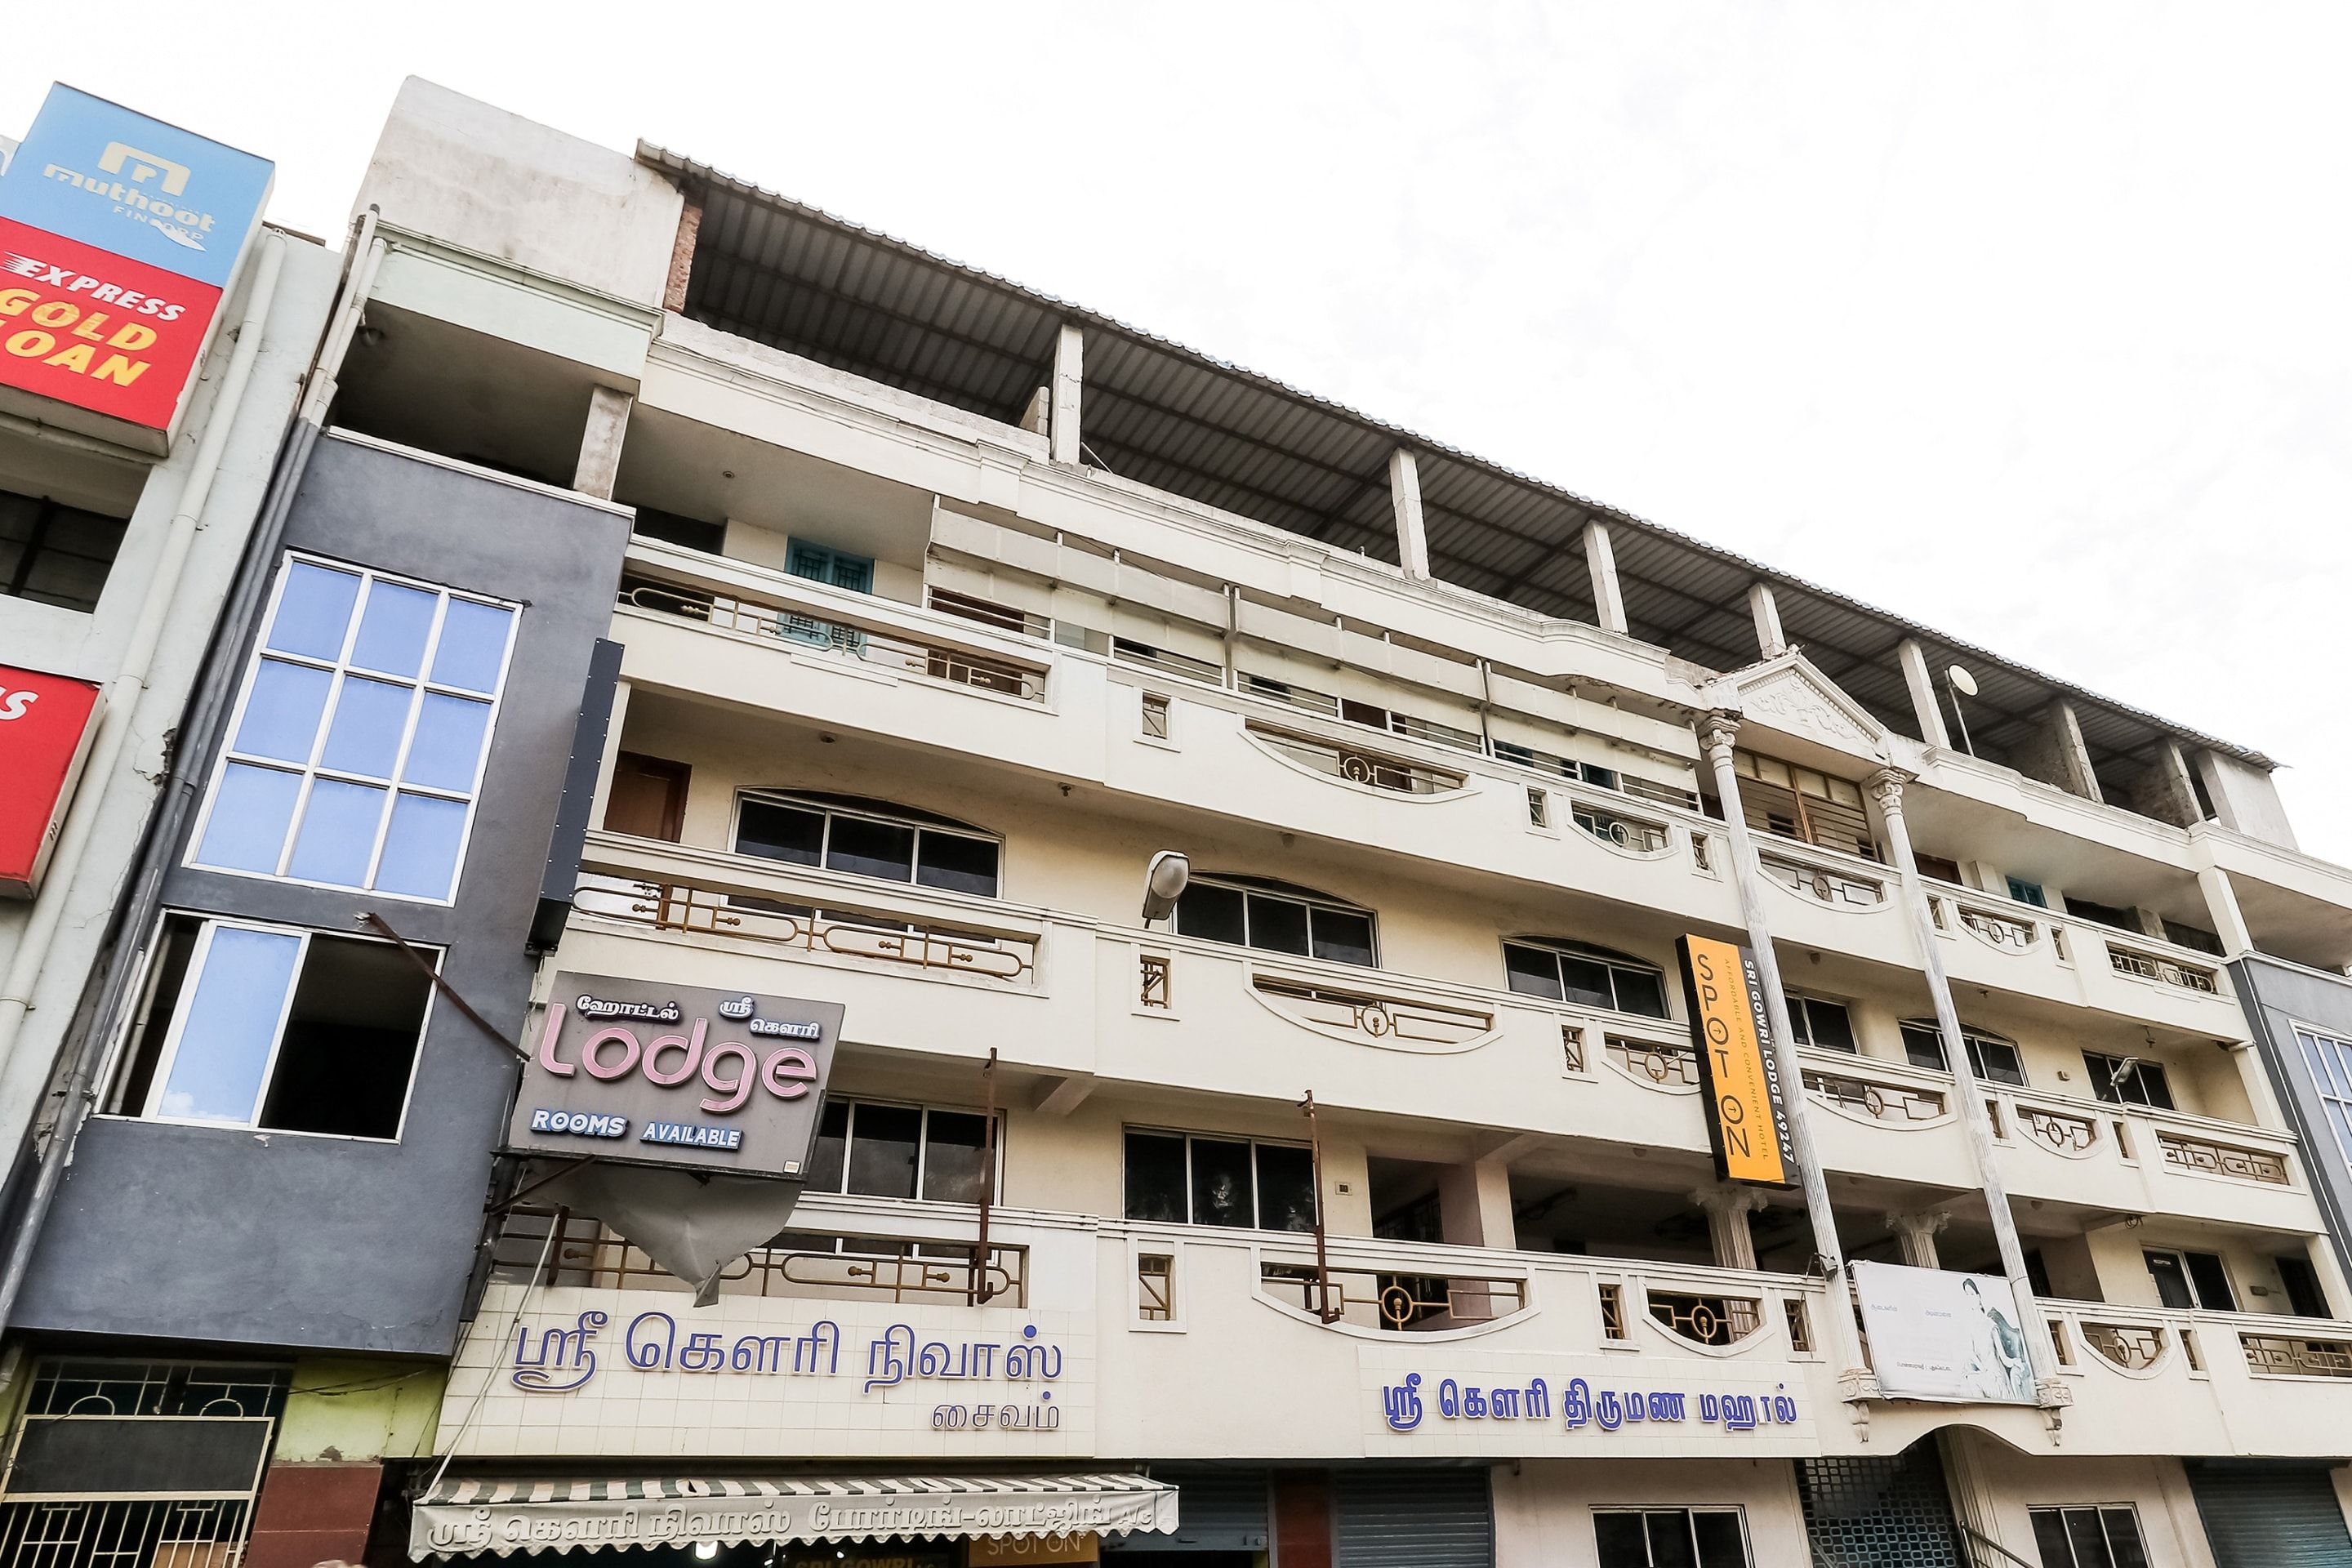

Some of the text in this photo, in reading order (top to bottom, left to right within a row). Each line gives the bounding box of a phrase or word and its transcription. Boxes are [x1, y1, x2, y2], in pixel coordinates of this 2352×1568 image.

[43, 163, 215, 232] muthoot
[113, 206, 204, 239] FINORP
[0, 251, 186, 320] EXPRESS
[0, 288, 158, 351] GOLD
[0, 319, 151, 387] OAN
[0, 684, 39, 721] S
[1697, 953, 1729, 1078] SPOT
[1724, 958, 1768, 1160] AFFORDABLE AND CONVENIENT HOTEL
[1744, 959, 1796, 1164] SRI GOWRI LODGE 49247
[531, 1109, 742, 1149] ROOMS AVAILABLE
[1721, 1094, 1751, 1158] ON
[864, 1323, 1063, 1394] நிவாஸ்
[929, 1390, 1061, 1430] சைவம்
[1561, 1377, 1688, 1431] திருமண
[1698, 1382, 1798, 1432] மஹால்
[987, 1533, 1080, 1556] SPOT ON
